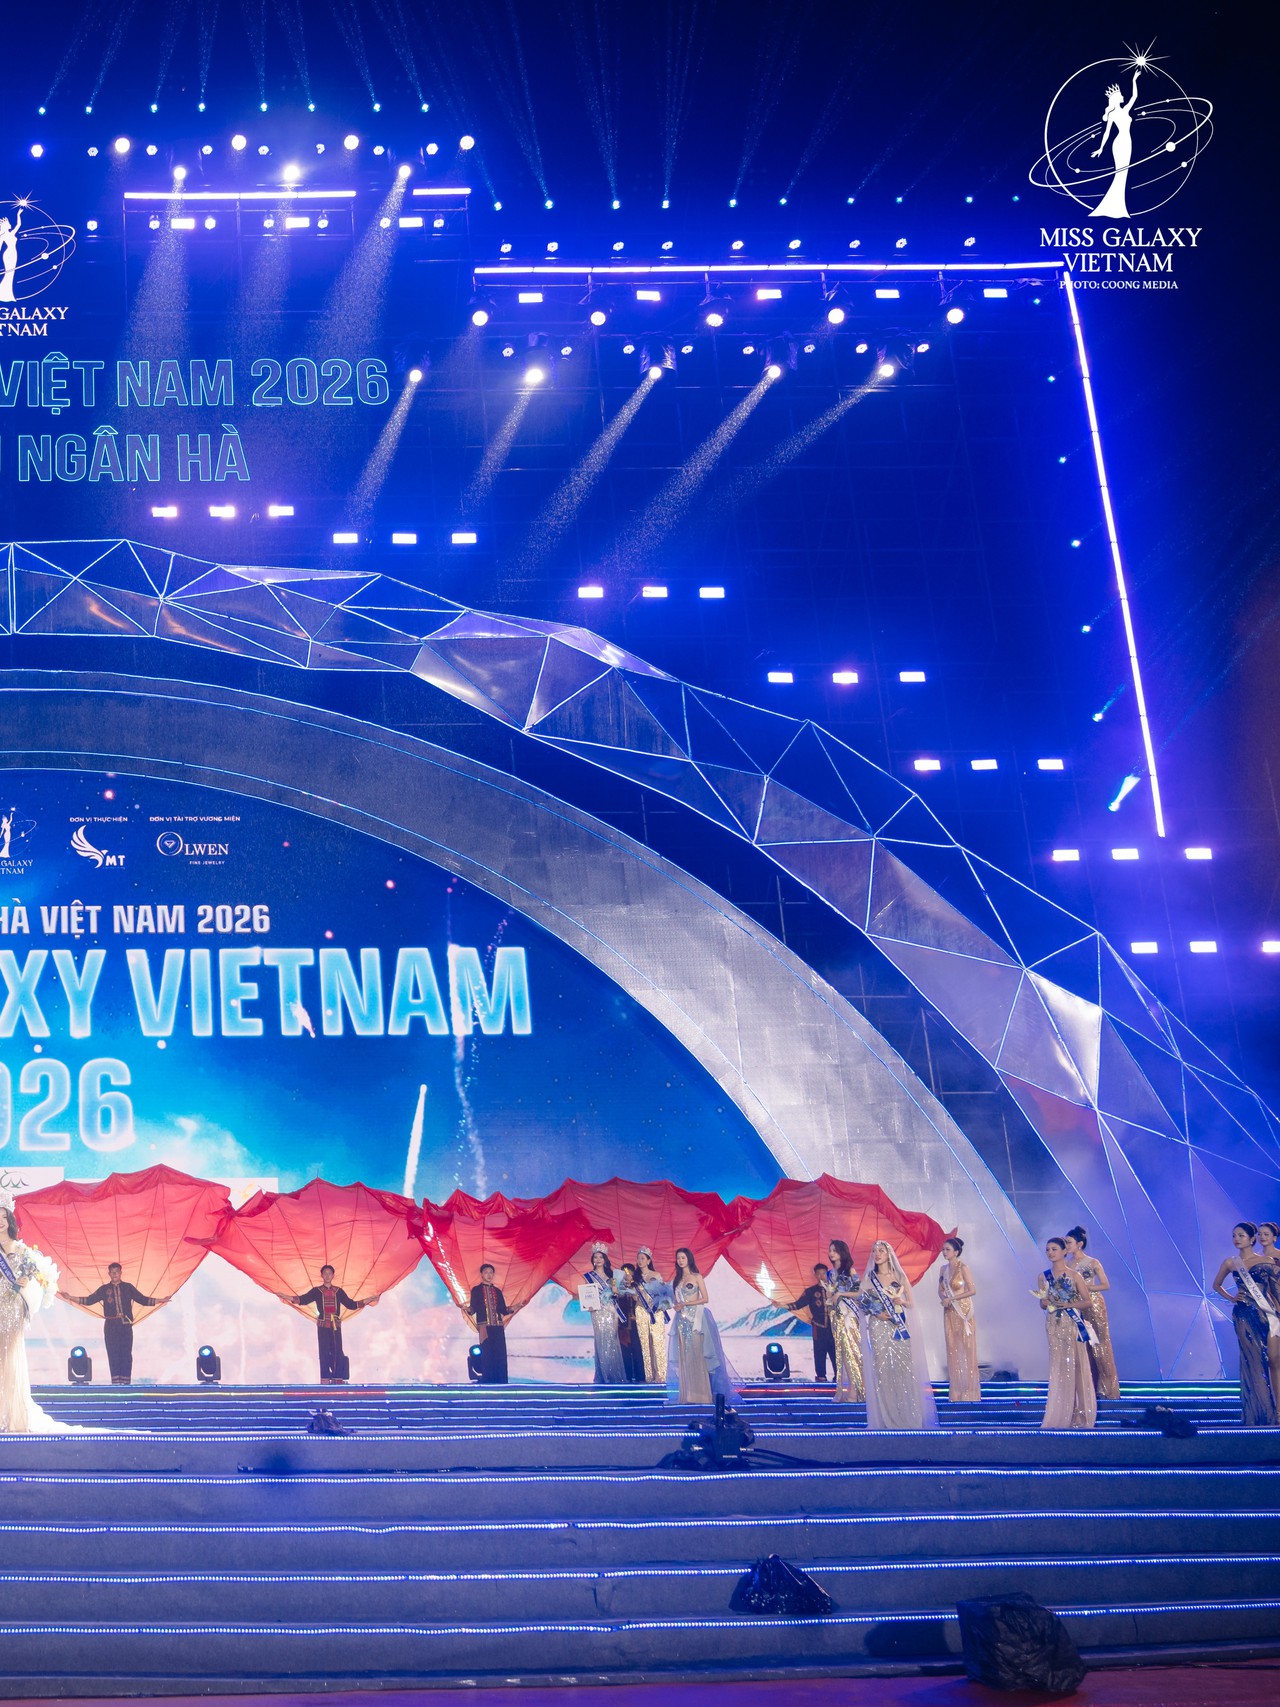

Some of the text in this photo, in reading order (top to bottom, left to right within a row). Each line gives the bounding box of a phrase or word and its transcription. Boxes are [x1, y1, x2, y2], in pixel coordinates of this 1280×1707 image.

[116, 359, 234, 408] NAM
[250, 357, 390, 407] 2026
[18, 425, 161, 482] NGÂN
[177, 423, 251, 482] HÀ
[0, 859, 34, 867] GALAXY
[105, 854, 126, 867] MT
[39, 899, 102, 939] VIỆT
[112, 904, 186, 934] NAM
[197, 904, 271, 934] 2026
[125, 947, 532, 1037] VIETNAM
